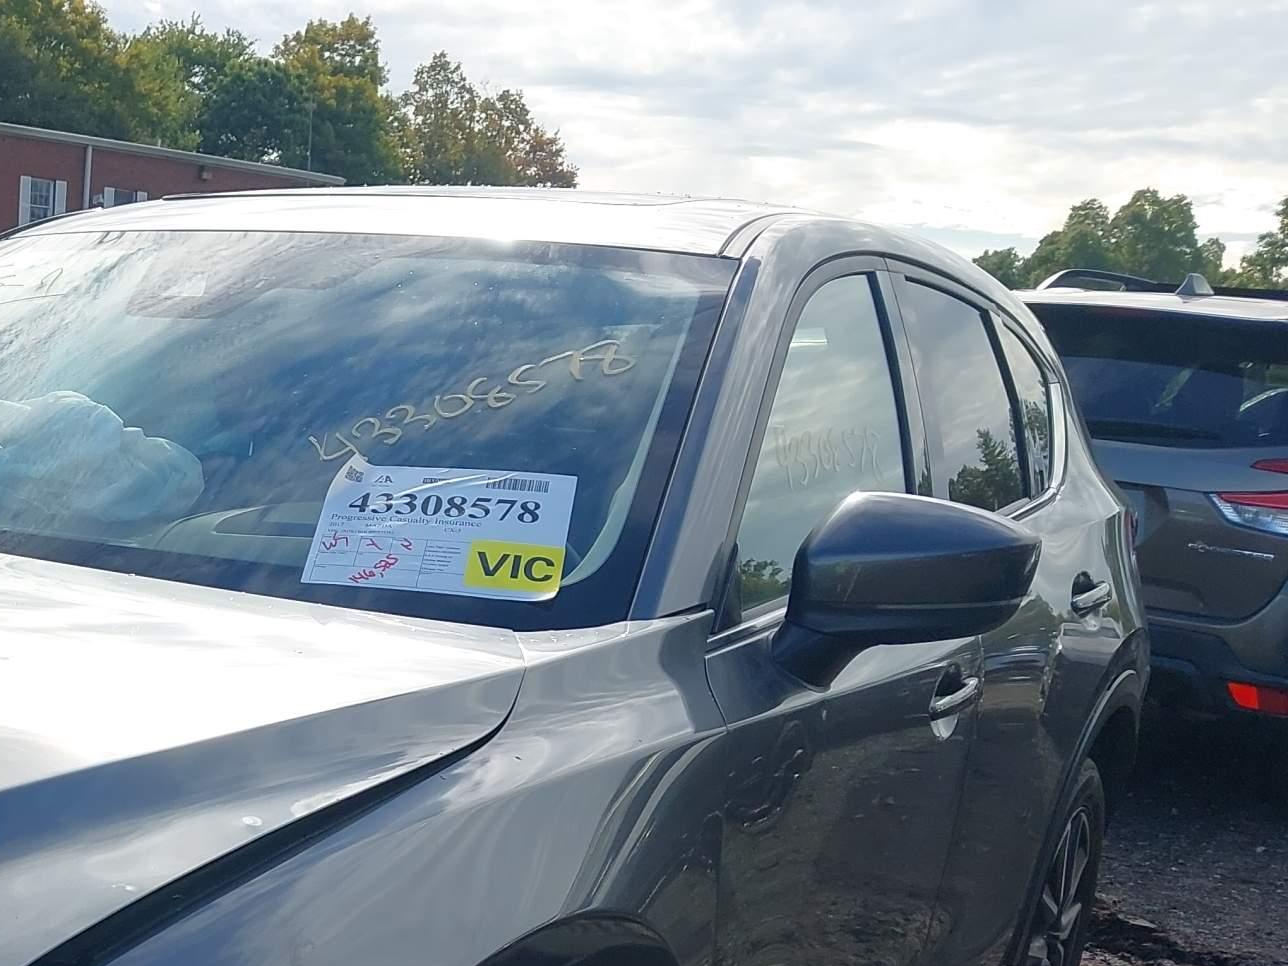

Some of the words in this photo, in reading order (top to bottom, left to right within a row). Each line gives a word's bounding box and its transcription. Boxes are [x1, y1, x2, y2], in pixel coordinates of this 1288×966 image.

[331, 513, 387, 523] Progressive
[389, 515, 432, 525] Casualty
[434, 517, 483, 528] Insurance
[349, 491, 541, 524] 43308578
[476, 551, 556, 583] VIC
